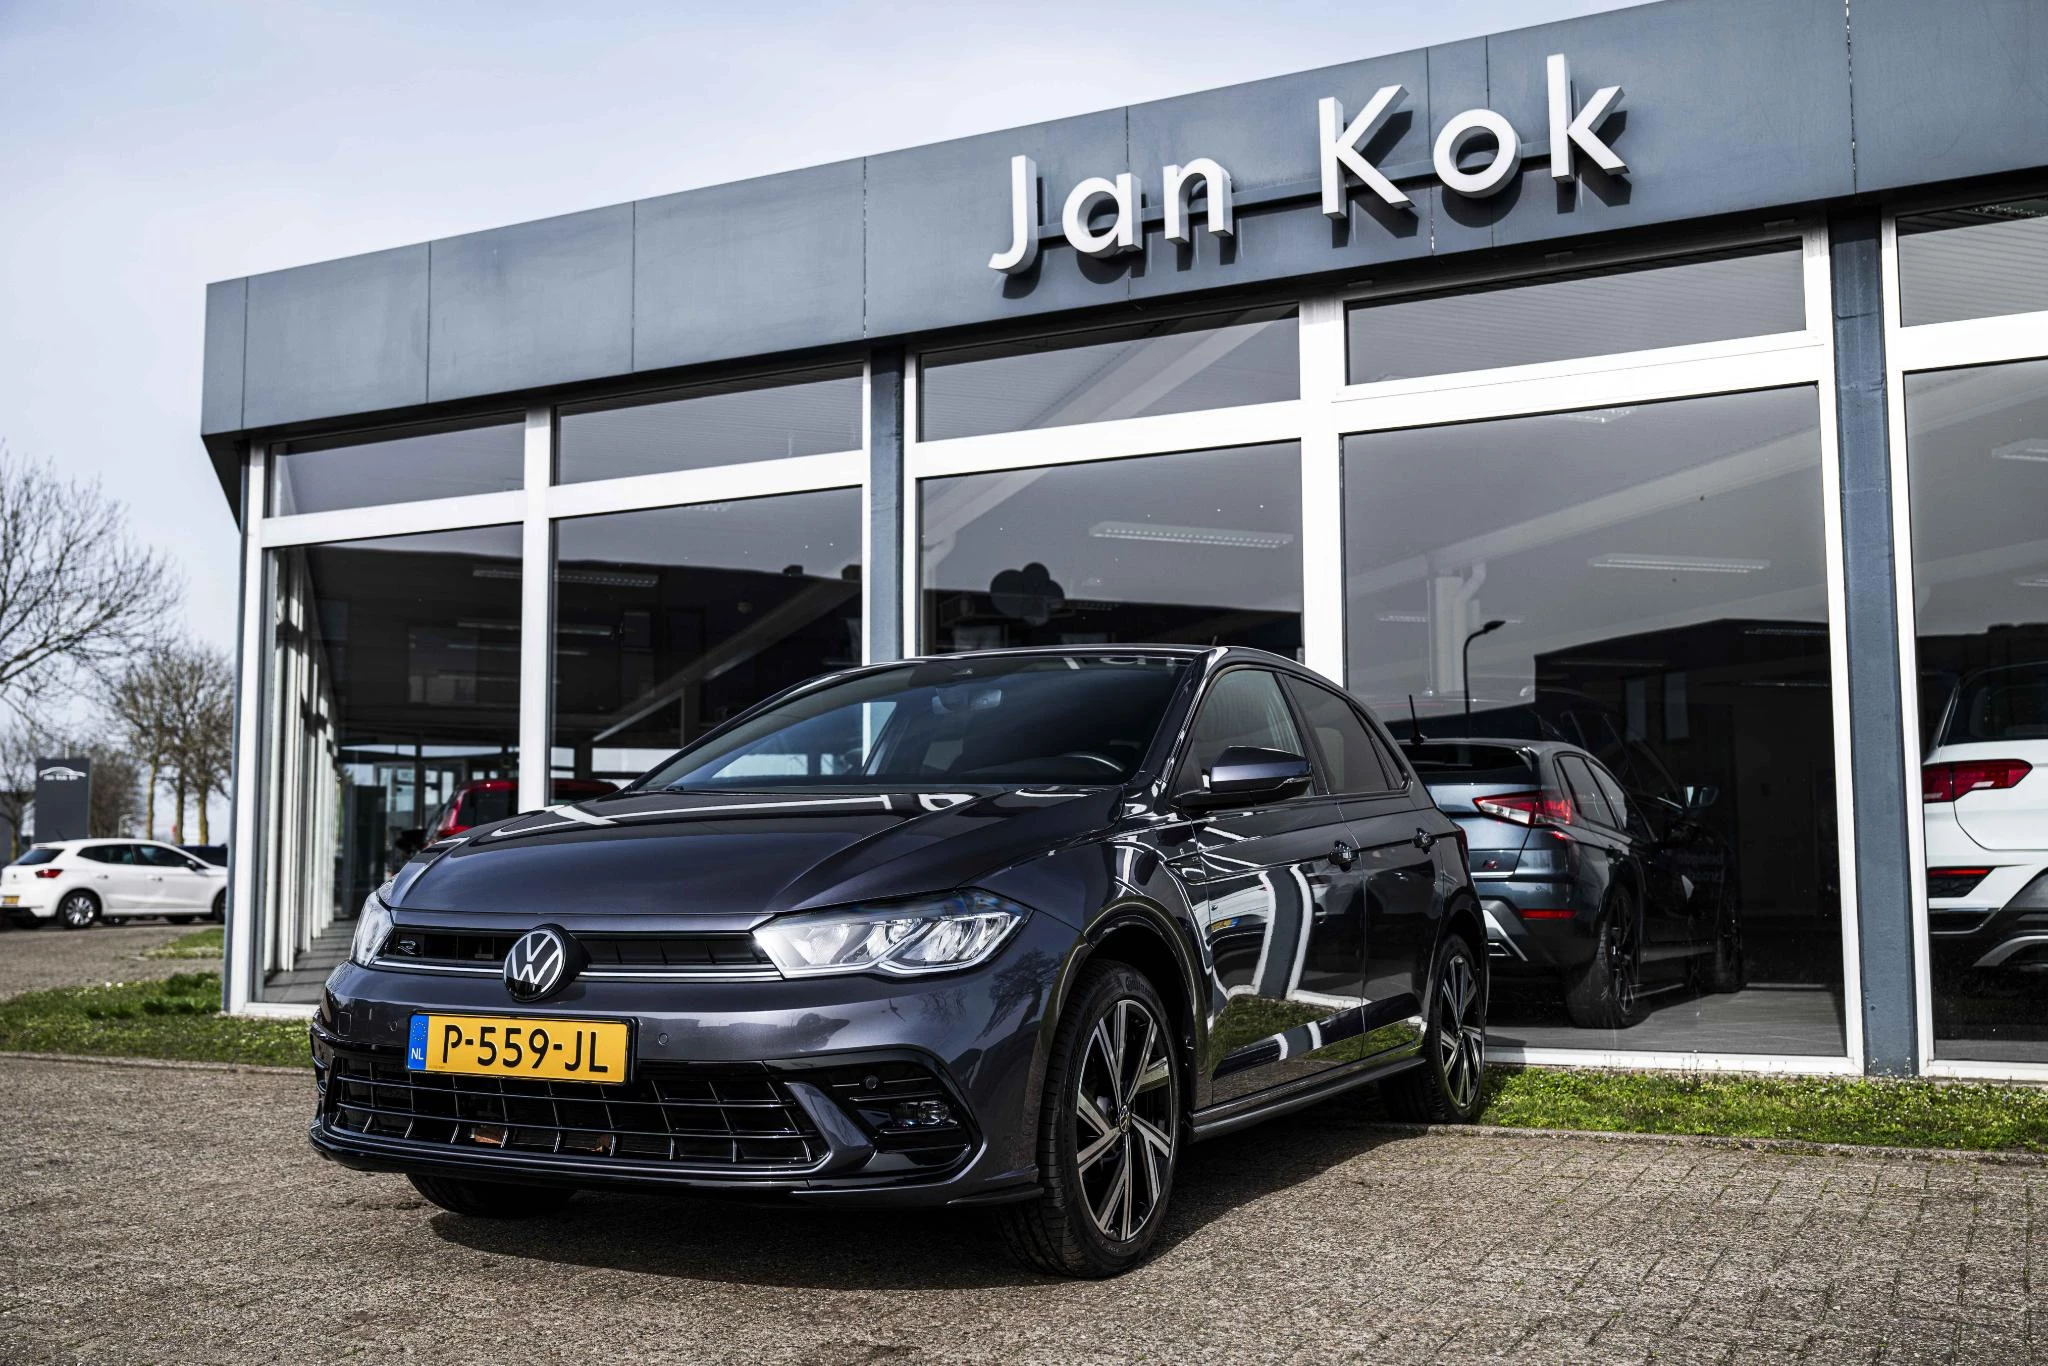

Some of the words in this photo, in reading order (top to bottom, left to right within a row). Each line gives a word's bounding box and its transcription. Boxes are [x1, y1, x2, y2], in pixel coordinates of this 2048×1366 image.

[988, 154, 1234, 275] Jan
[1318, 53, 1630, 220] Kok
[411, 1047, 424, 1060] NL
[442, 1024, 608, 1073] P-559-JL
